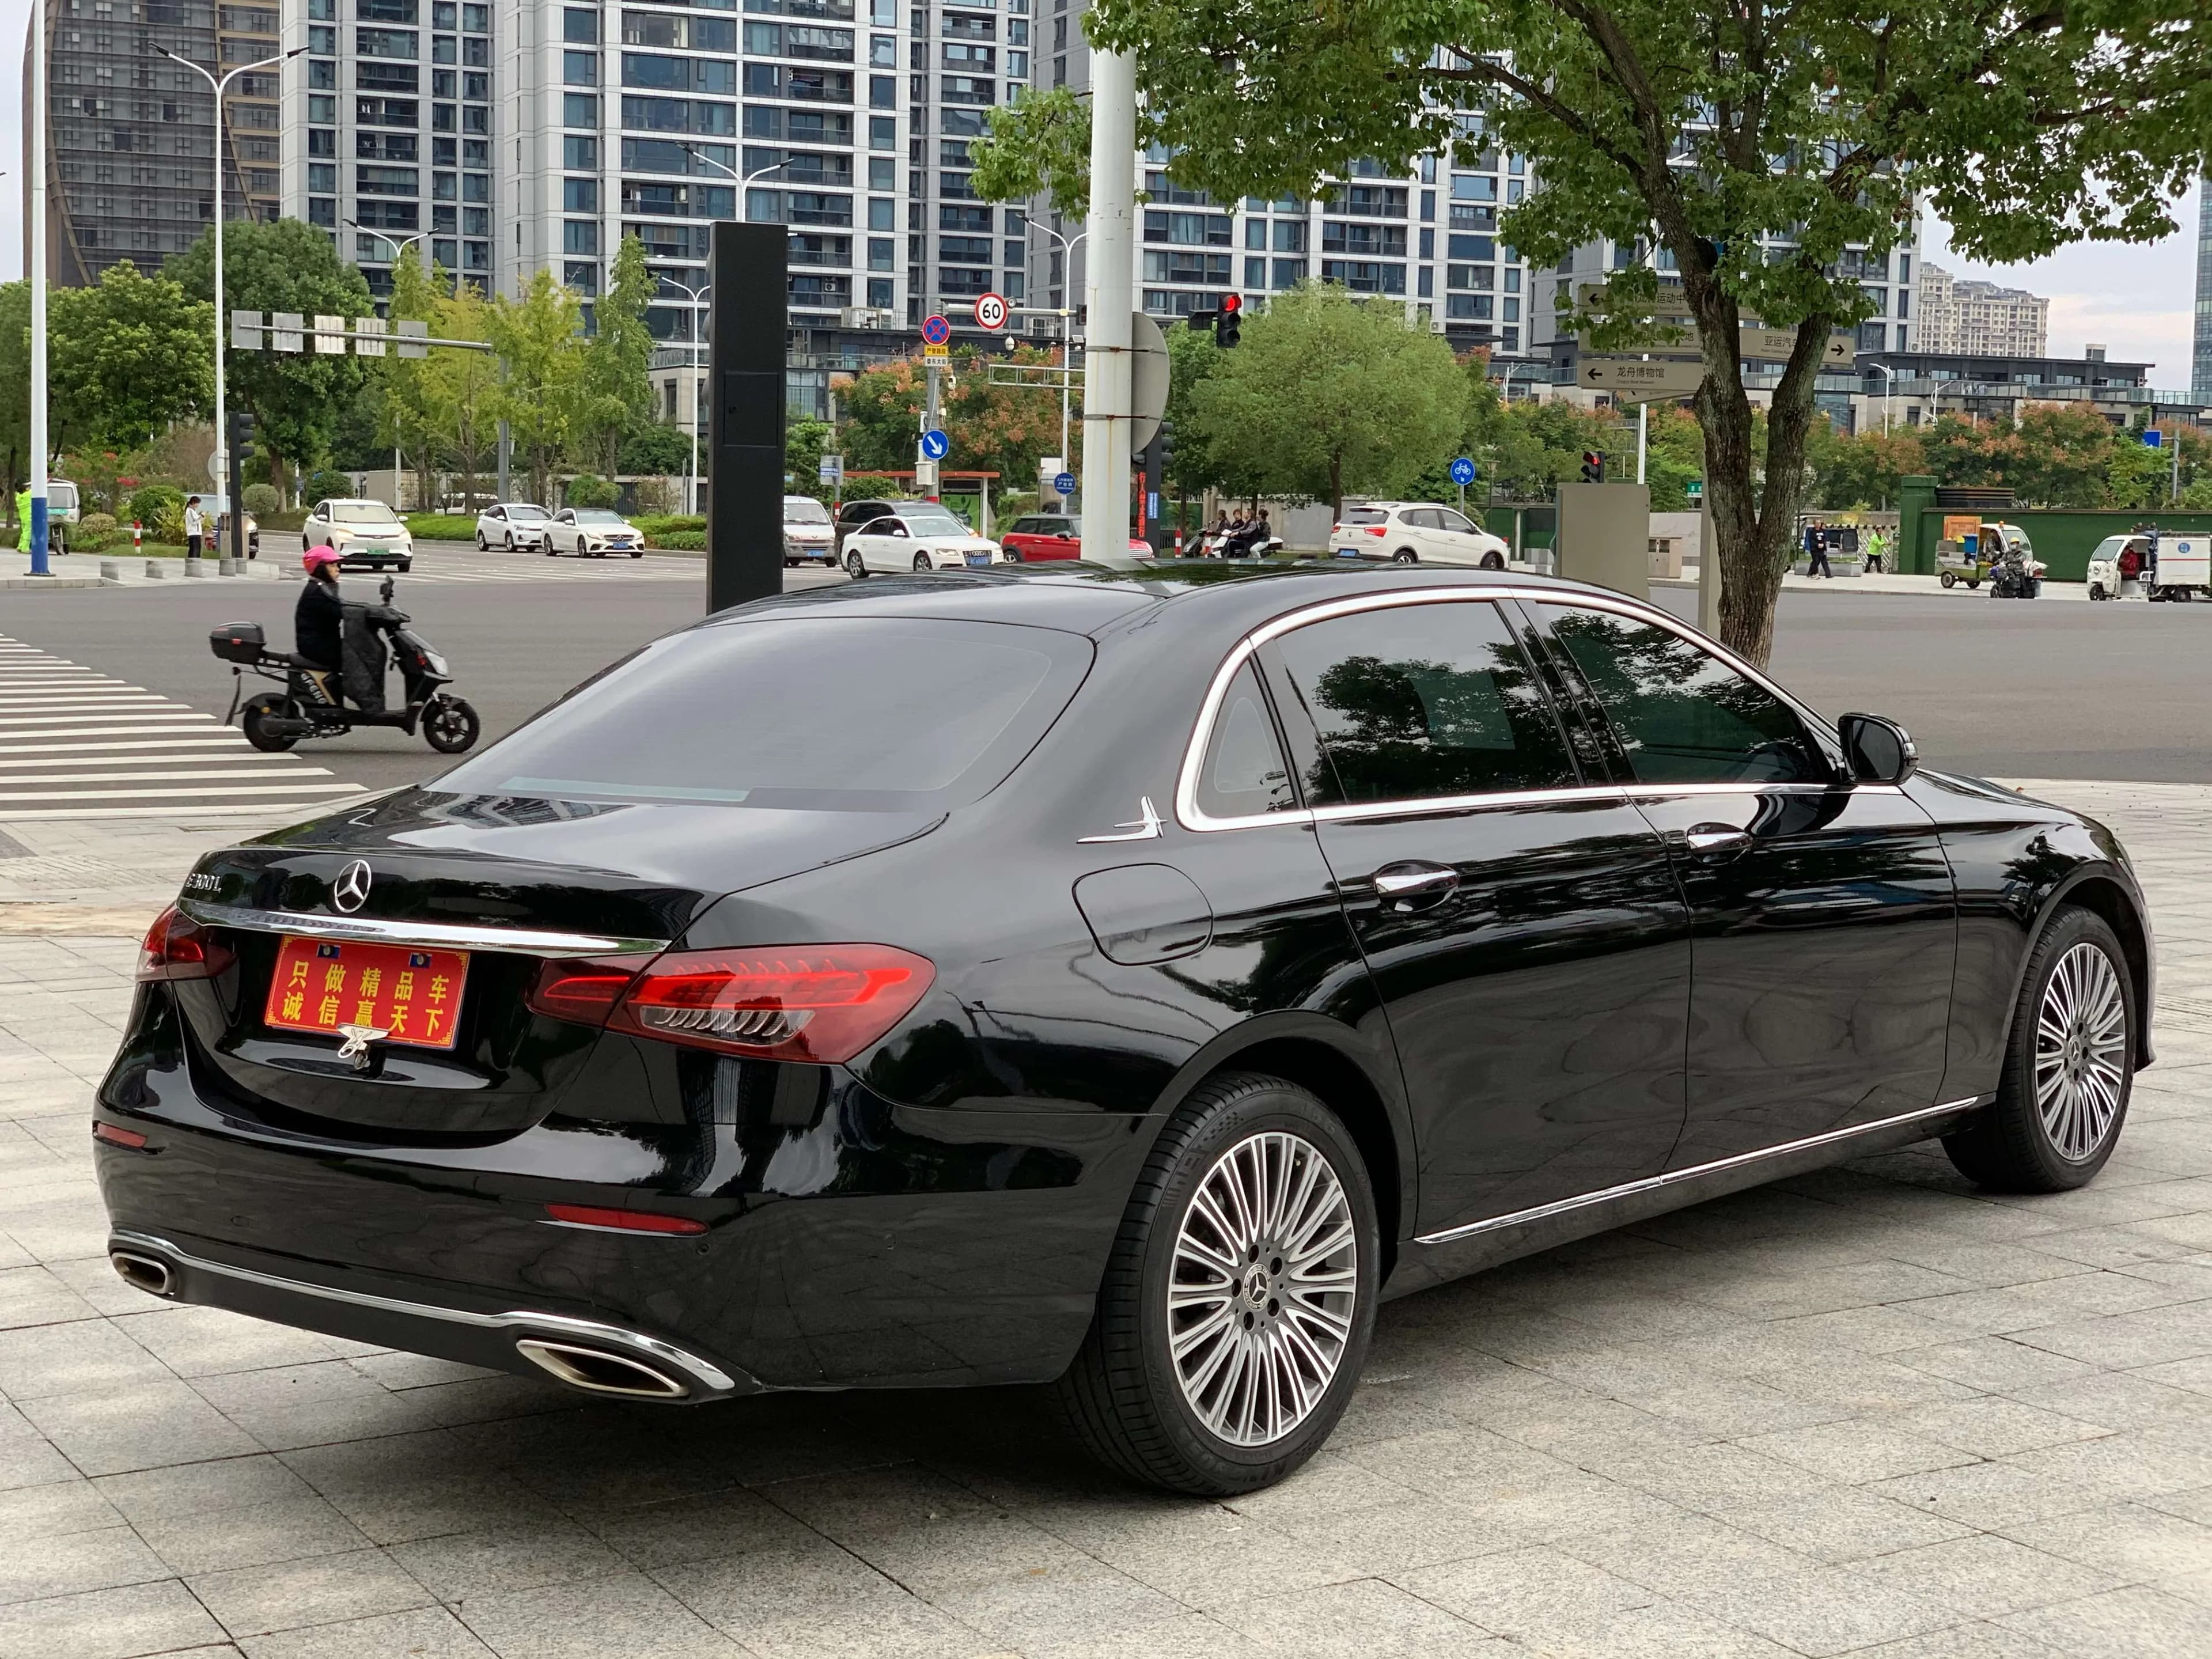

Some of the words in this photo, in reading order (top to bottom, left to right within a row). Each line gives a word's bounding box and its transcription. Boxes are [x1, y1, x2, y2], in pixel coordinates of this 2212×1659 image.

[983, 303, 1001, 319] 60
[1617, 366, 1664, 378] 龙舟博物馆
[288, 960, 449, 1004] 只做精品车
[282, 991, 444, 1037] 诚信赢天下
